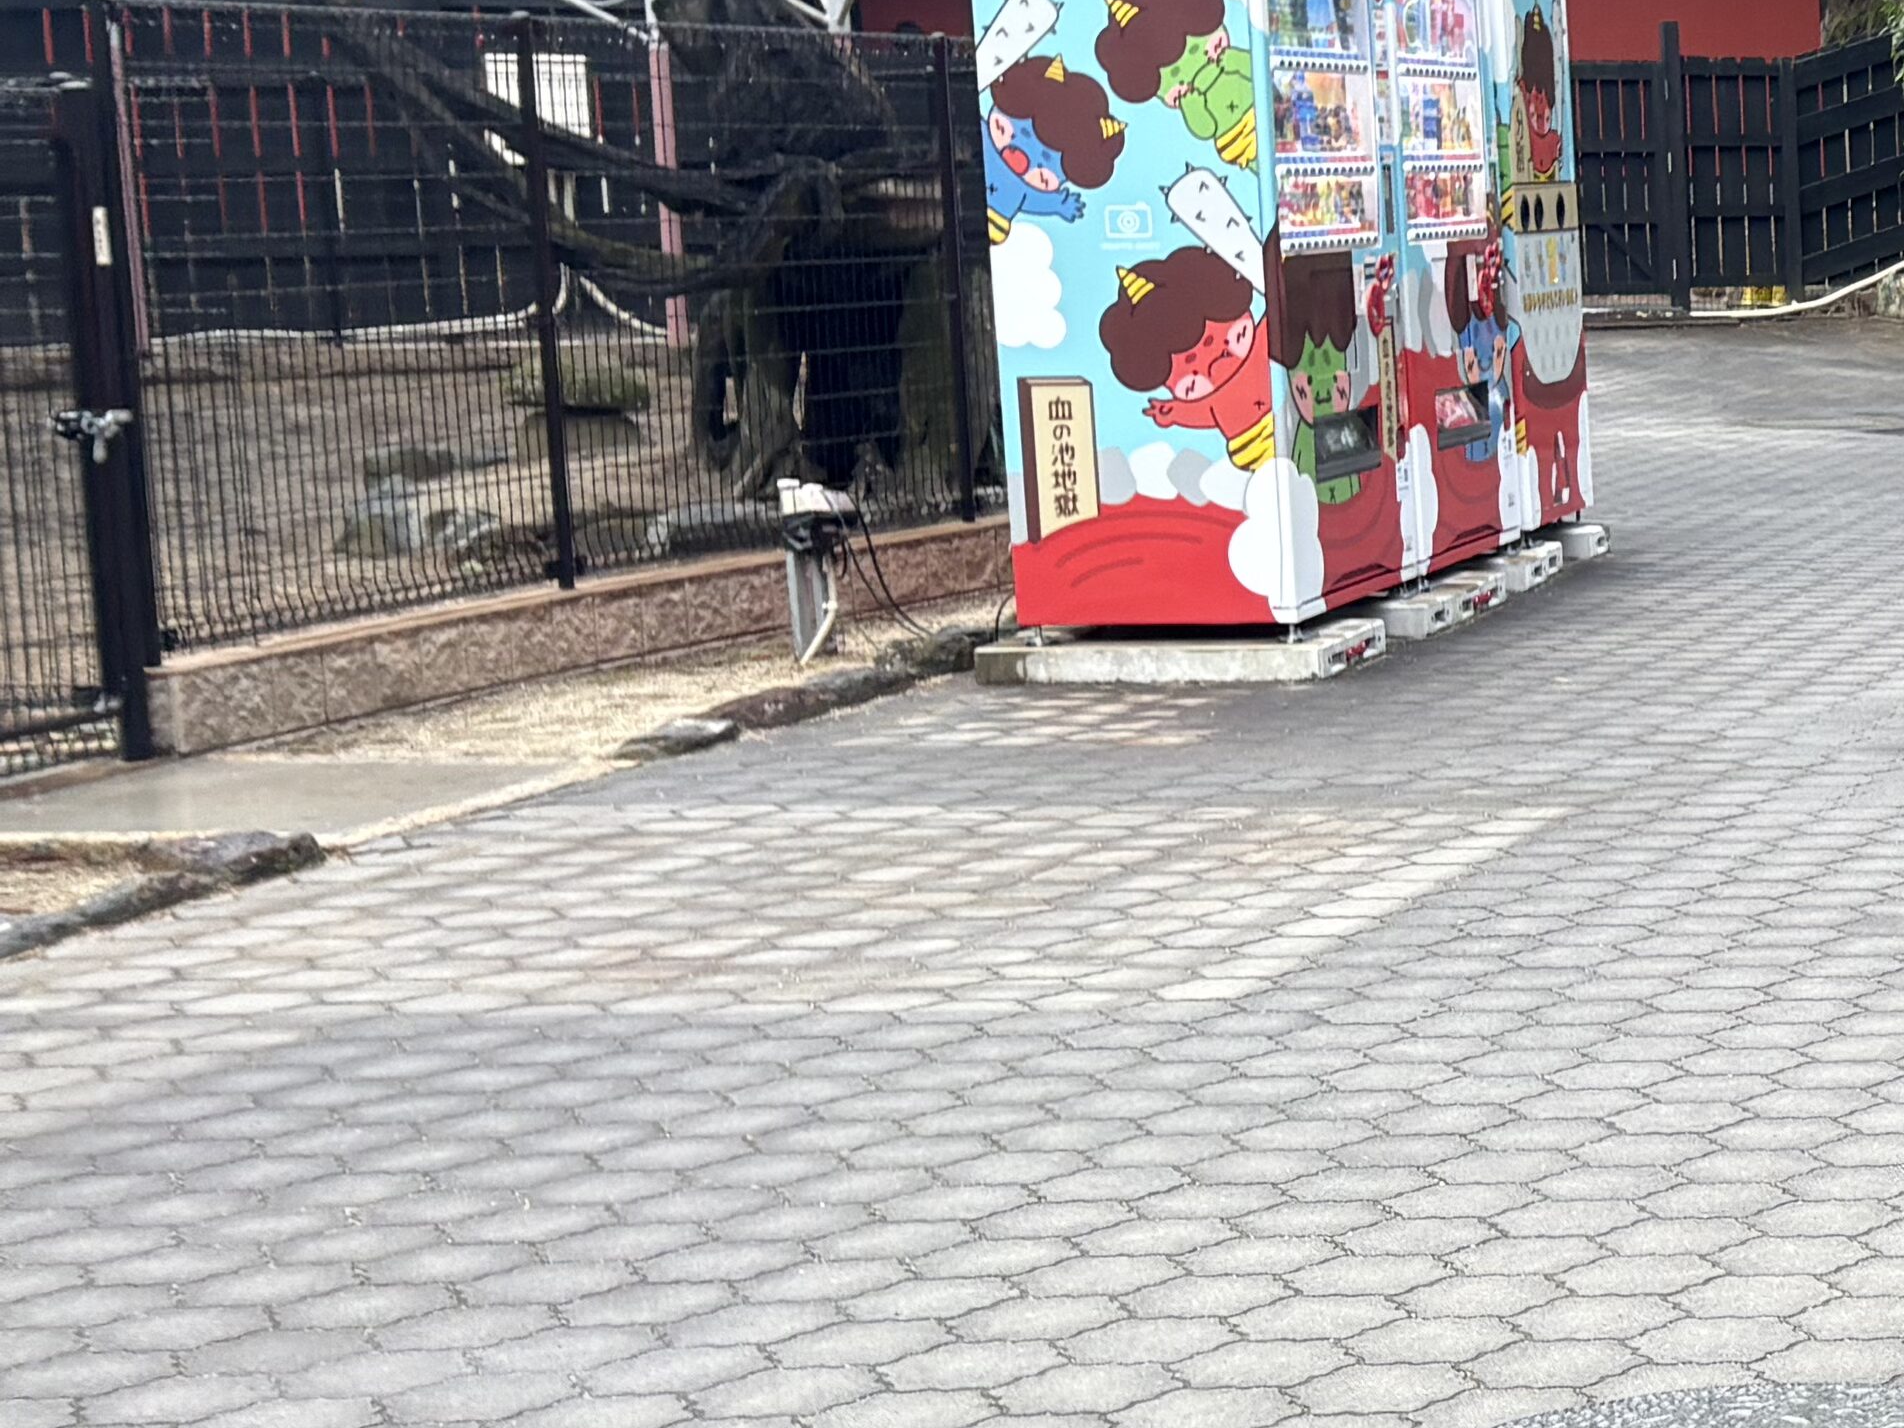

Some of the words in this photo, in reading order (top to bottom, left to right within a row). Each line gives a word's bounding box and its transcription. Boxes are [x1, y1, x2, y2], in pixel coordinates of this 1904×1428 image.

[1047, 395, 1080, 519] 血の池地獄
